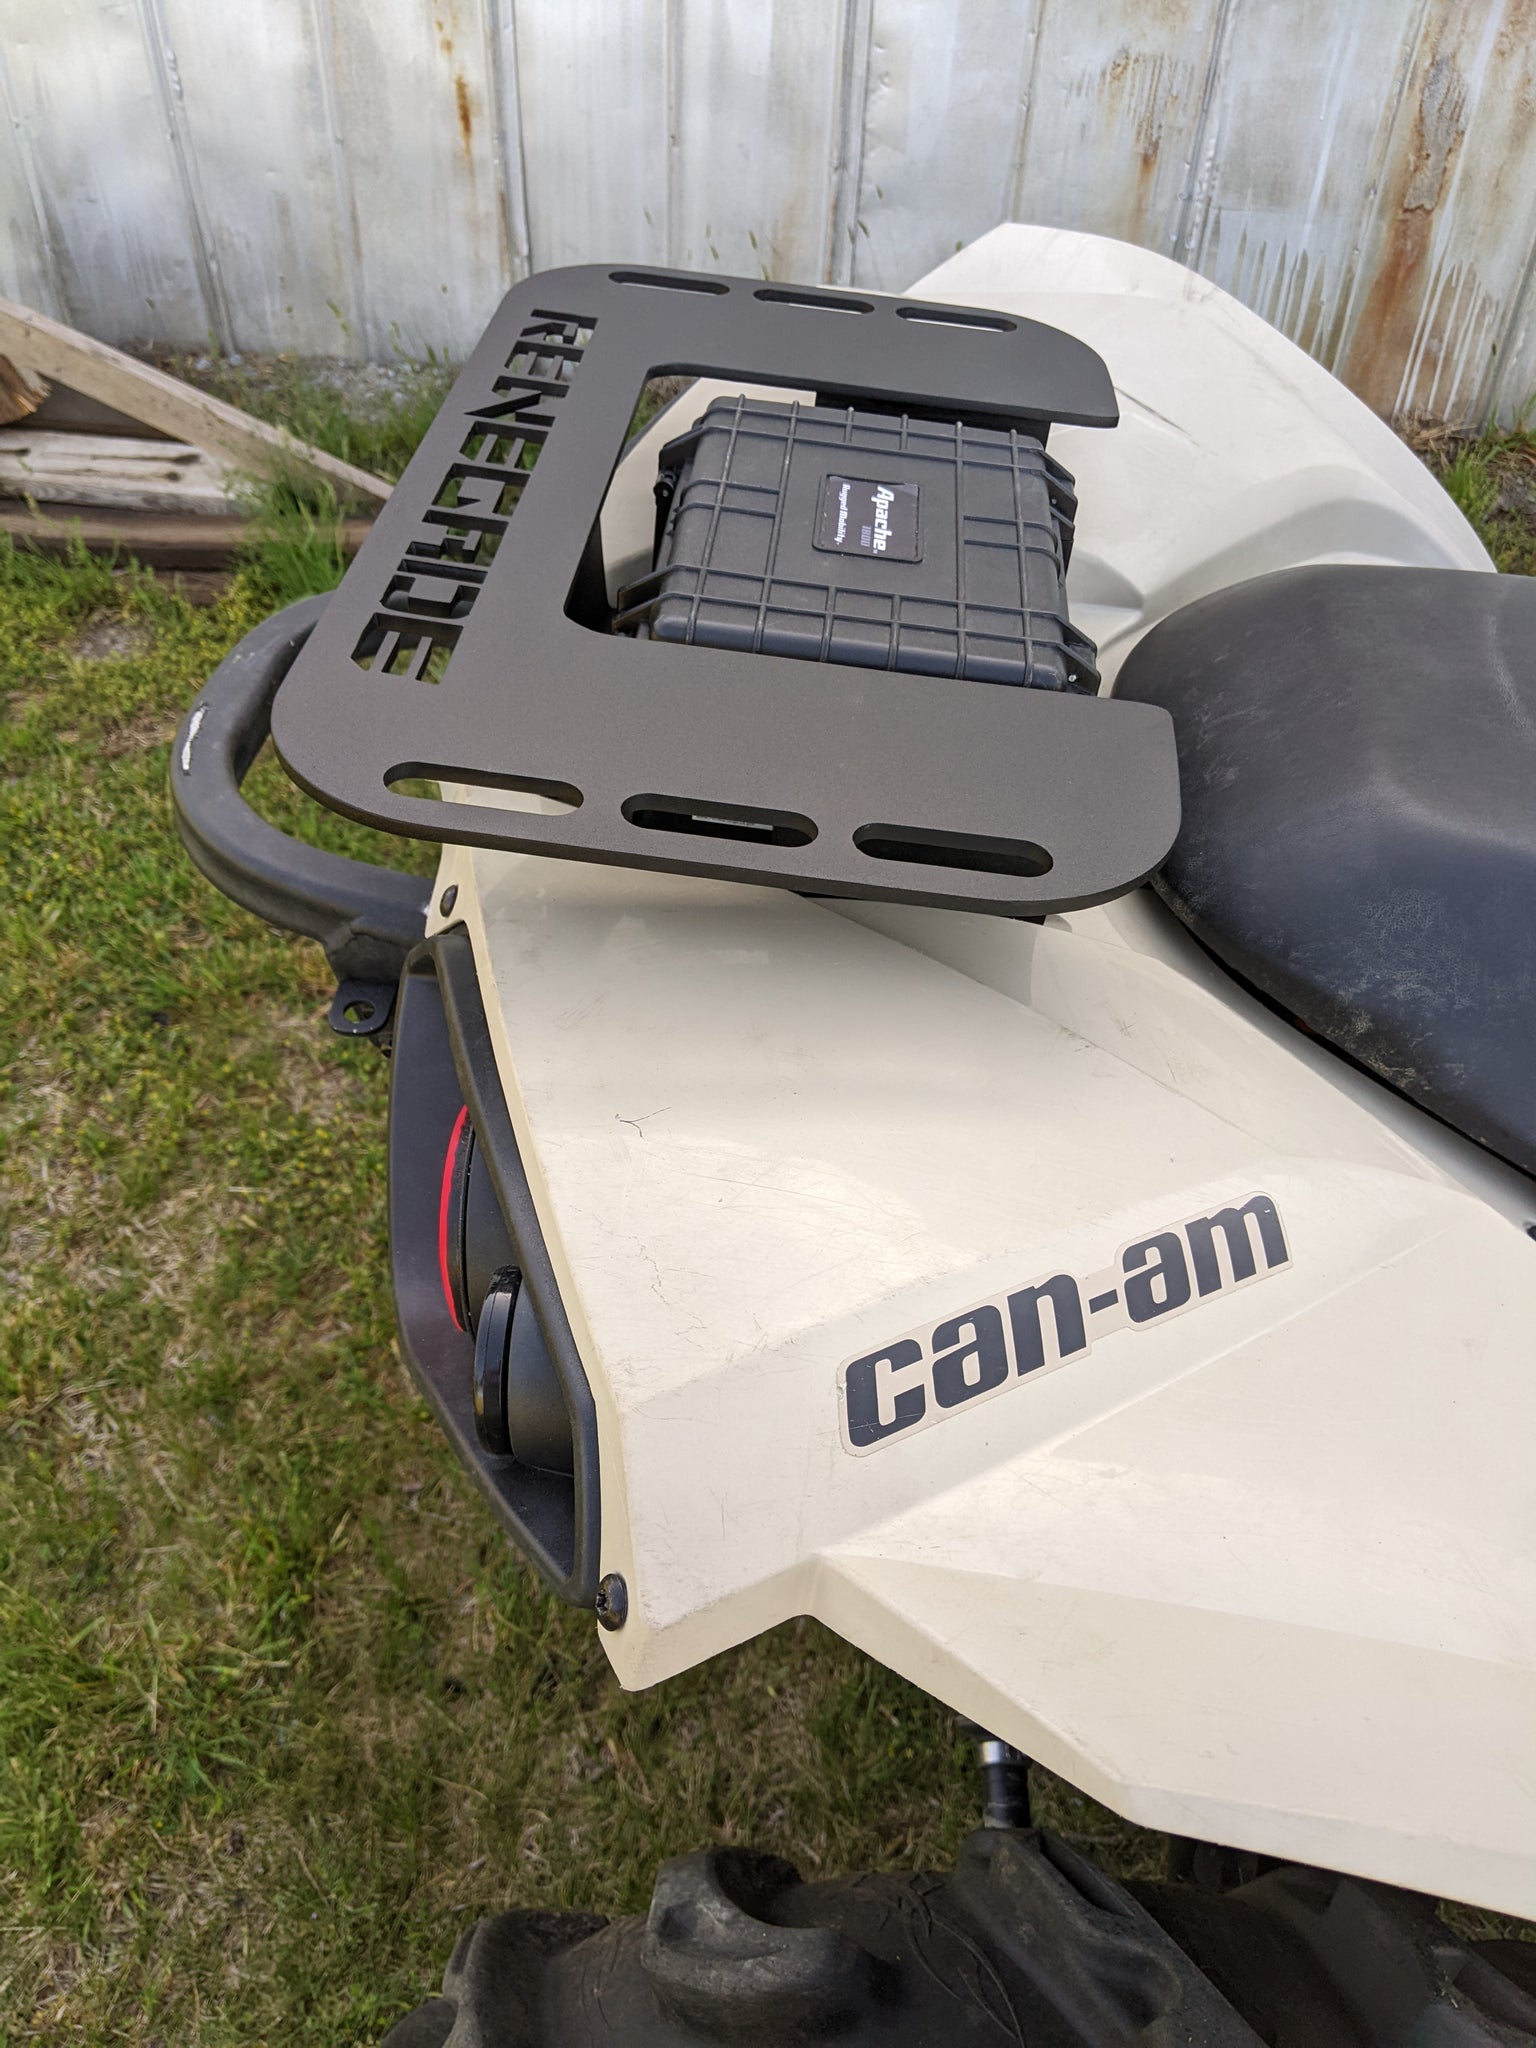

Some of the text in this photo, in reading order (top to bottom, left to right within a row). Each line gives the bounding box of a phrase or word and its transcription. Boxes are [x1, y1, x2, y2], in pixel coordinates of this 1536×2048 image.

[350, 308, 598, 685] RENEGADE
[838, 483, 851, 511] Rugged
[871, 485, 895, 551] Apache
[860, 525, 872, 548] 1800
[846, 1195, 1289, 1447] can-am
